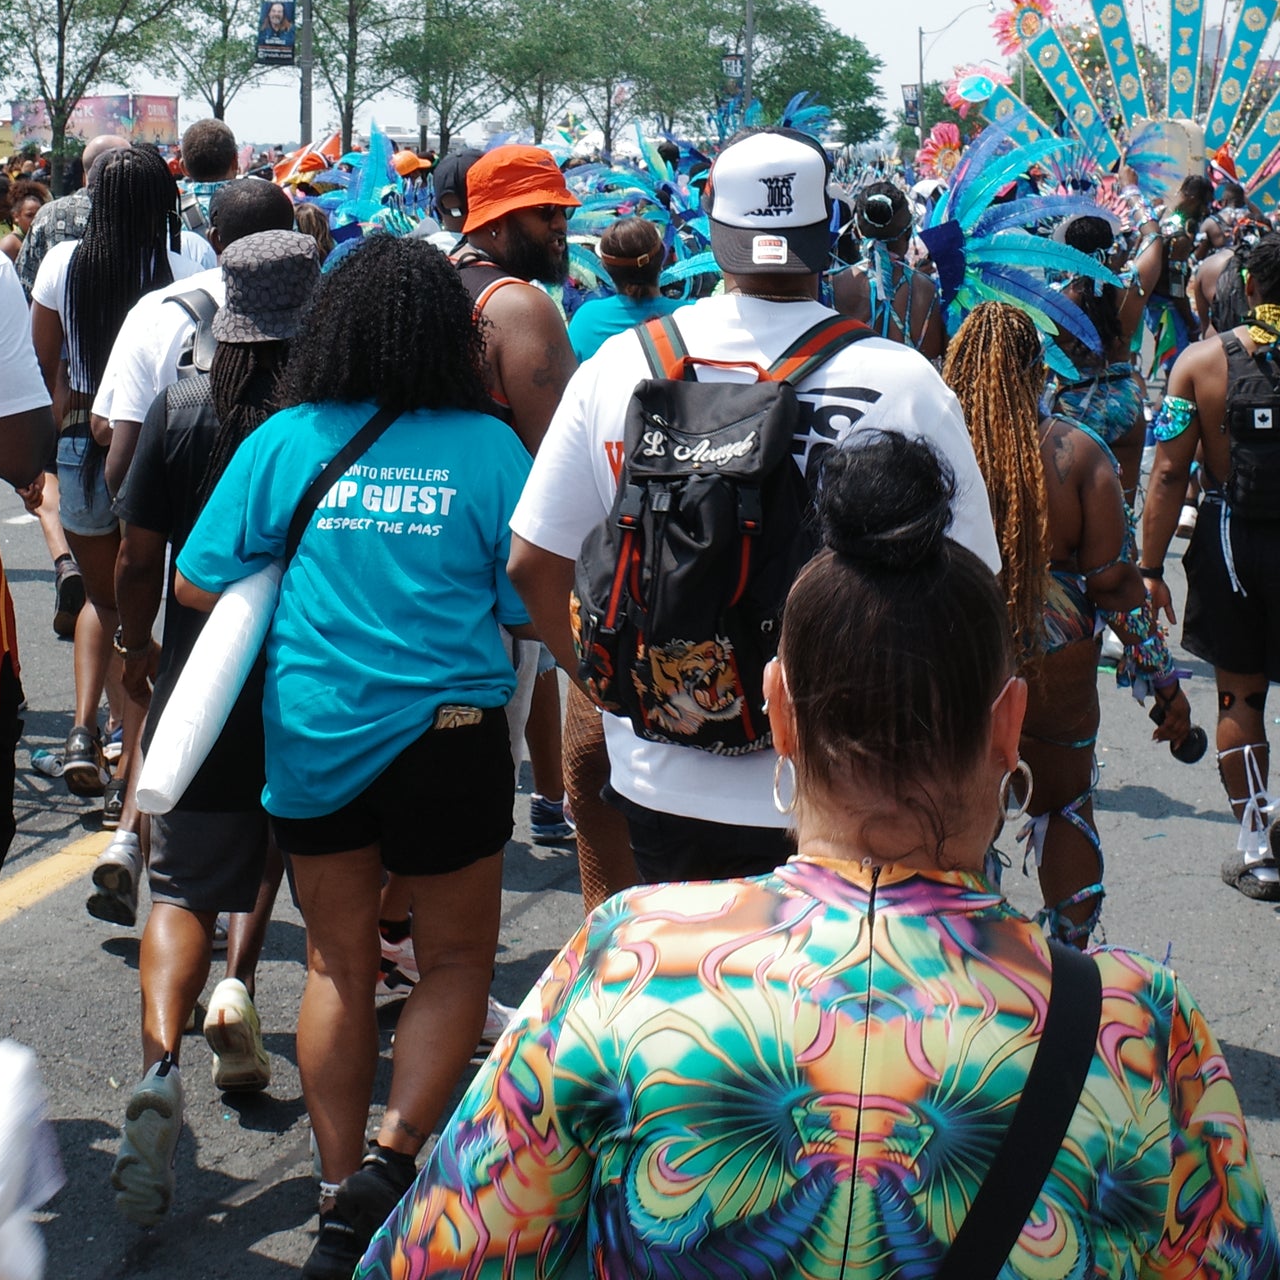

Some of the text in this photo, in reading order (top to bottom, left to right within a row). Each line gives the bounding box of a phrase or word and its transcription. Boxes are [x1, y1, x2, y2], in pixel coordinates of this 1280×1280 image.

[147, 104, 169, 116] DRINK
[320, 463, 451, 483] TONTO REVELLERS
[362, 483, 457, 517] GUEST
[316, 517, 443, 537] RESPECT THE MAS
